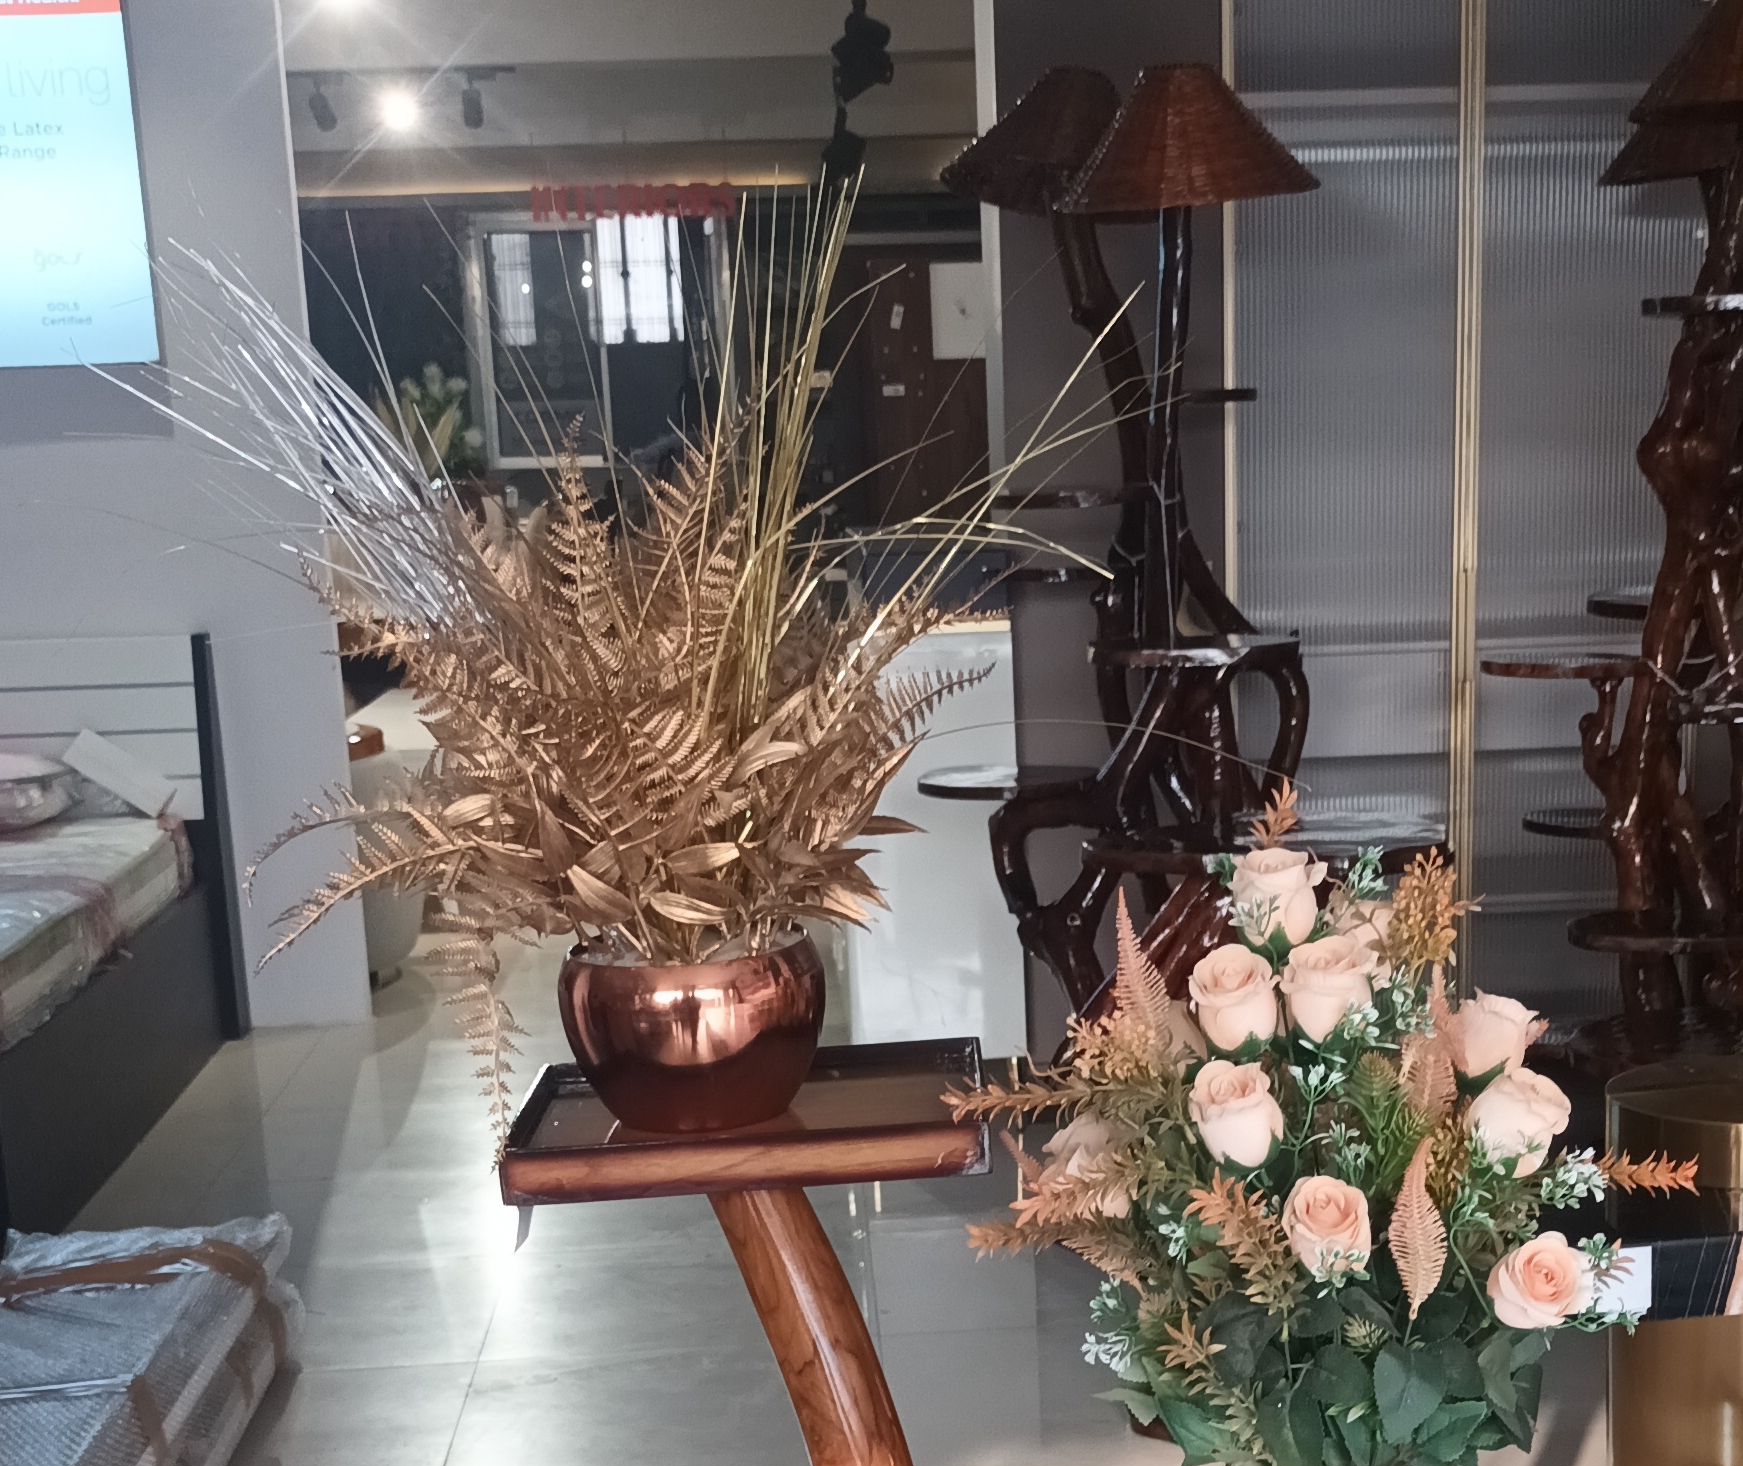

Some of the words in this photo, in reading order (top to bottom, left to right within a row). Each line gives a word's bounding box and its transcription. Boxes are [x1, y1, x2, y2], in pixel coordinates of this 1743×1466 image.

[6, 58, 111, 107] living
[13, 121, 64, 137] Latex
[0, 145, 57, 162] Range
[41, 315, 92, 327] Certified
